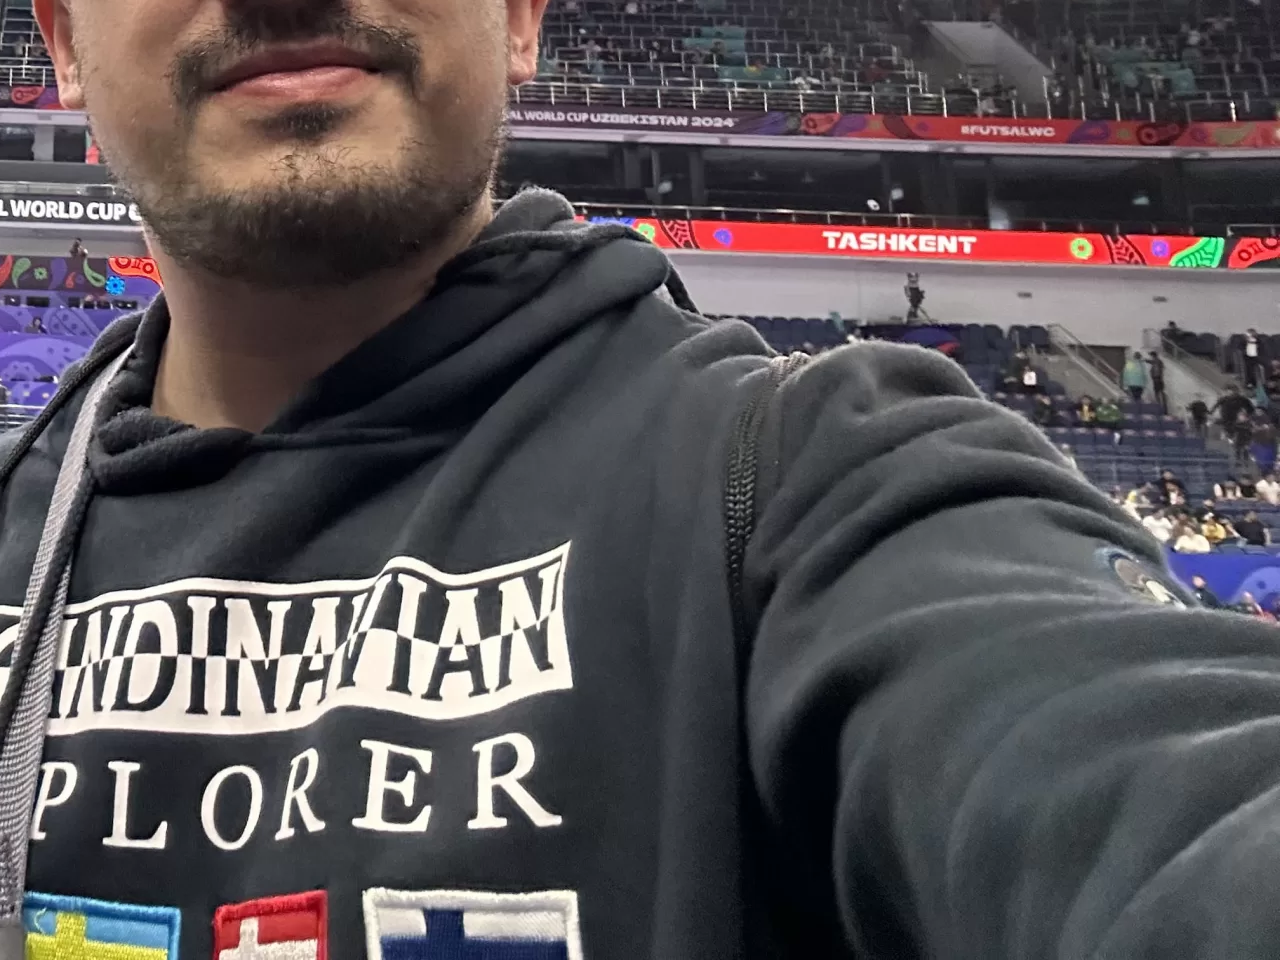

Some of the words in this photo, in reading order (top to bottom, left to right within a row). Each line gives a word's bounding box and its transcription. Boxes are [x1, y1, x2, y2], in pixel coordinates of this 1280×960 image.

[524, 111, 565, 122] WORLD
[566, 112, 589, 123] CUP
[589, 113, 688, 126] UZBEKISTAN
[960, 123, 1056, 138] #FUTSALWC
[10, 199, 84, 220] WORLD
[85, 202, 128, 222] CUP
[822, 231, 977, 254] TASHKENT
